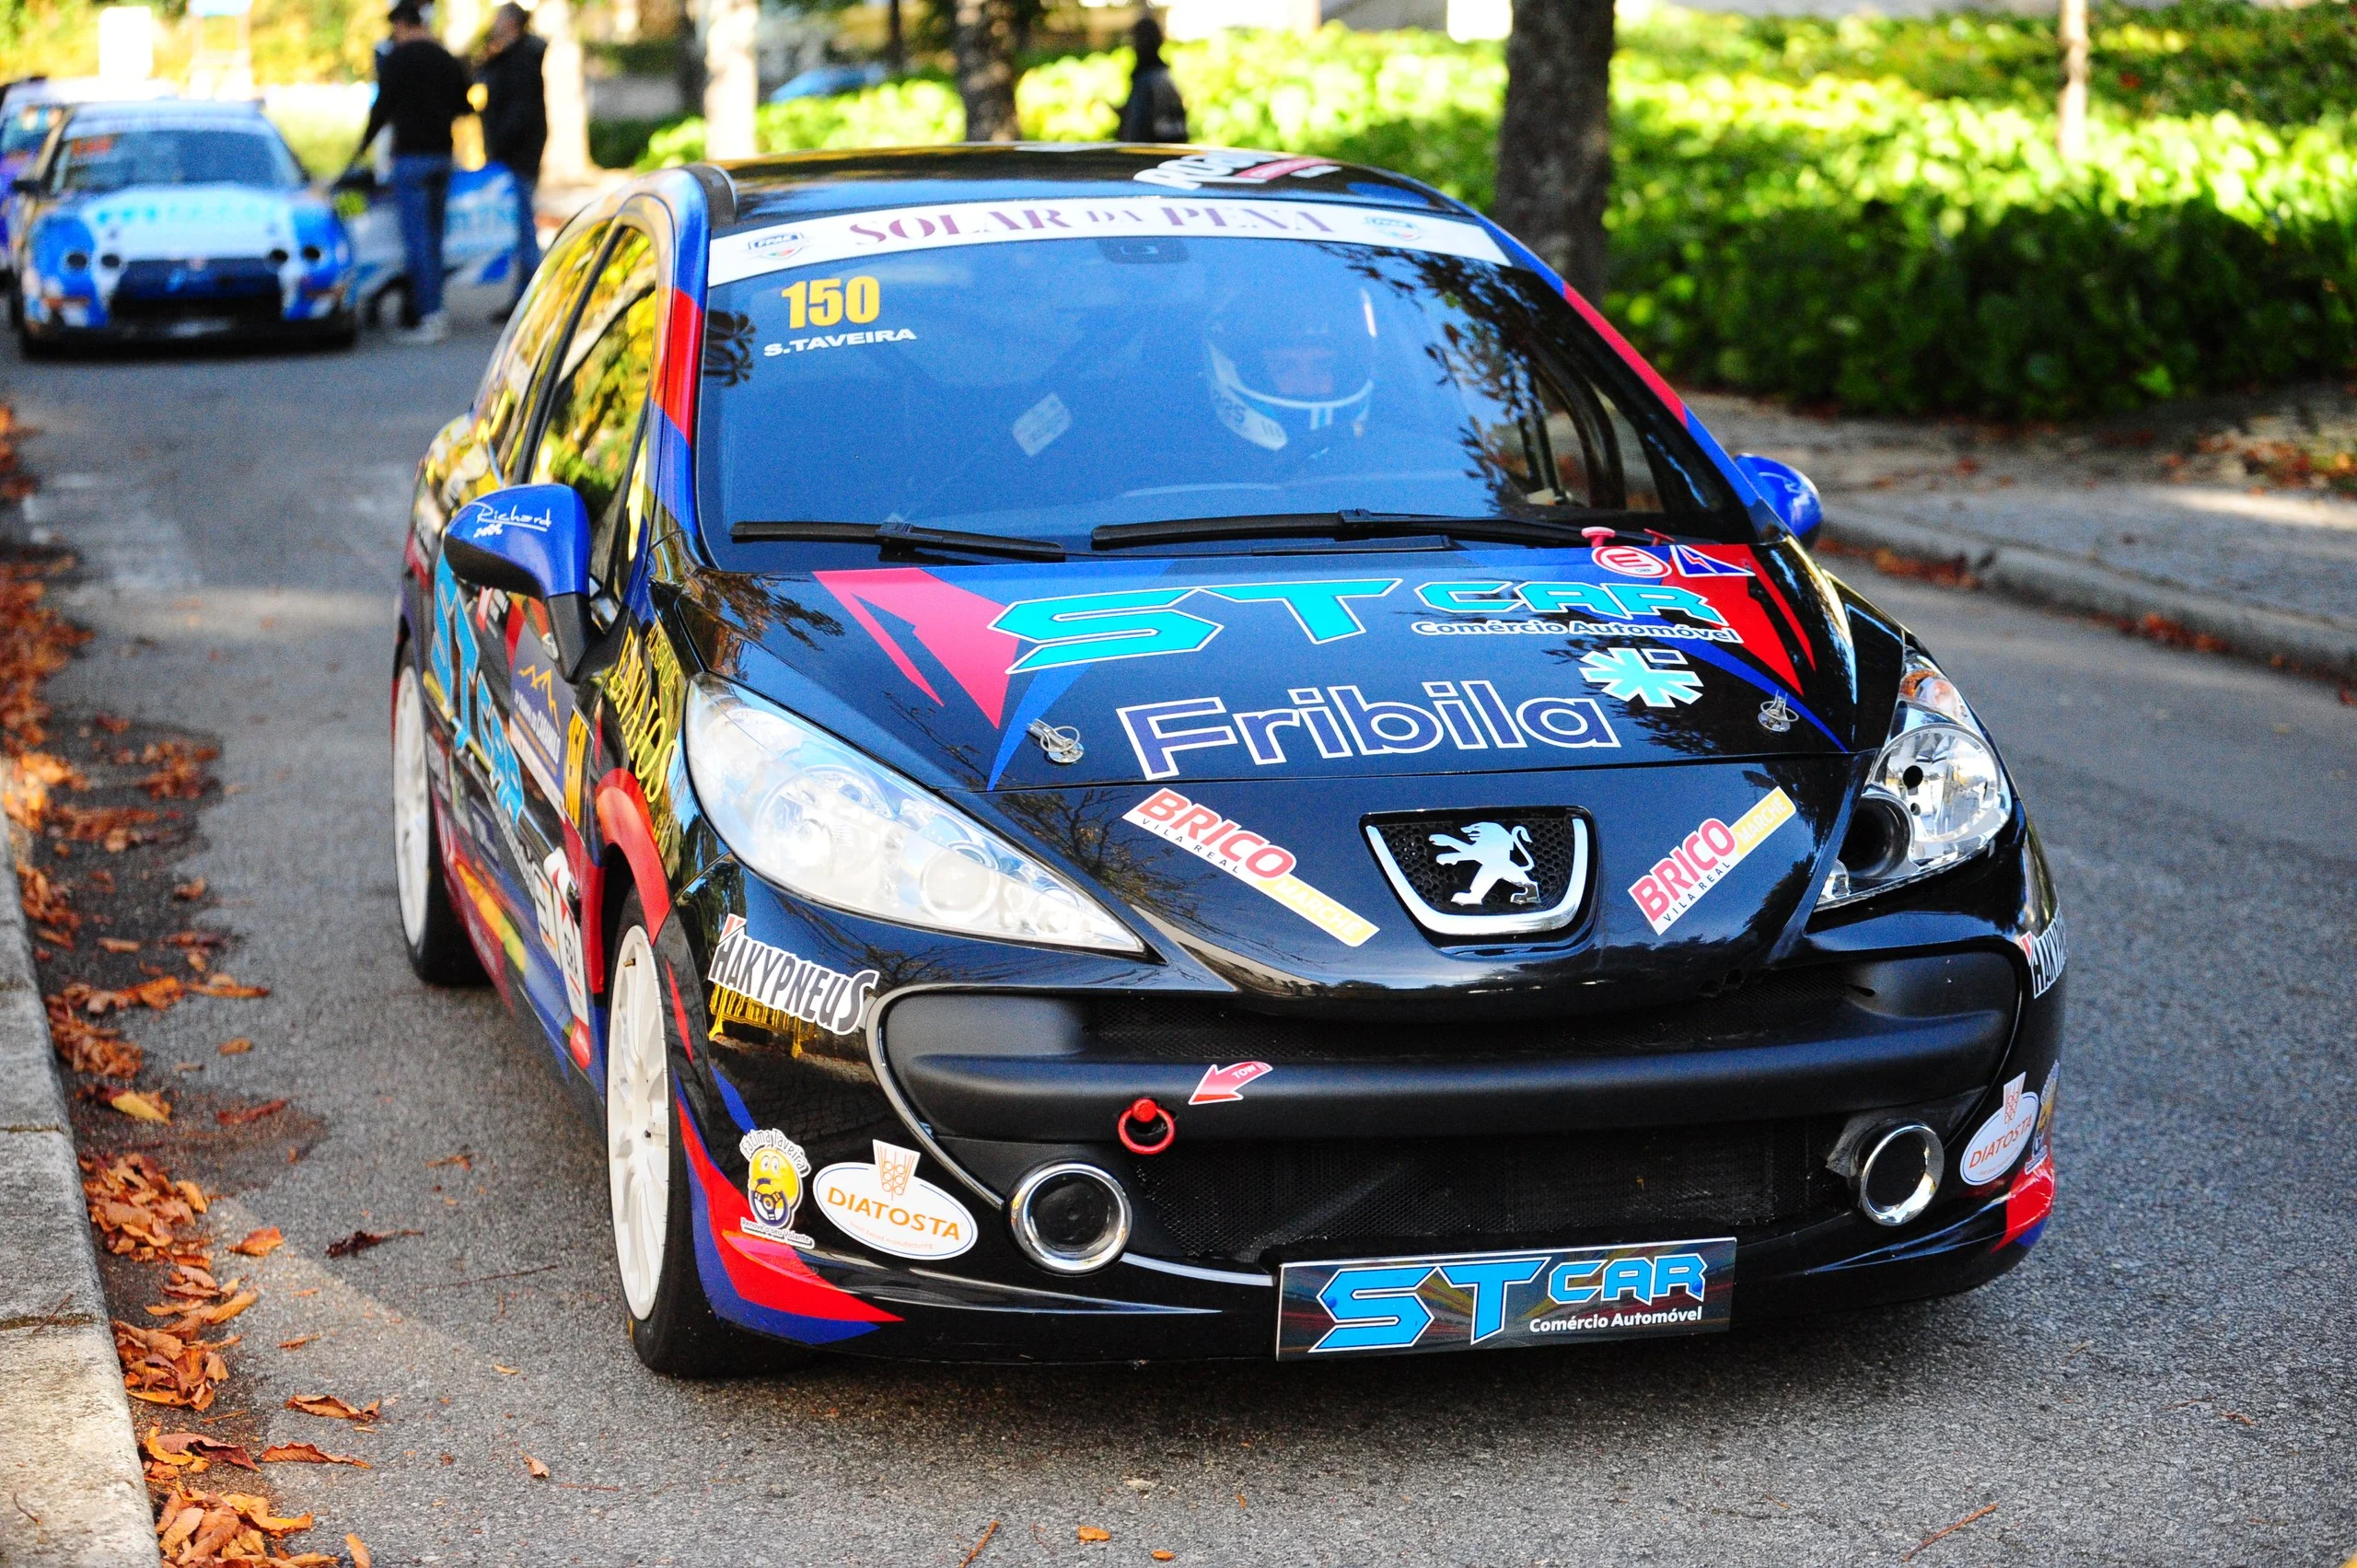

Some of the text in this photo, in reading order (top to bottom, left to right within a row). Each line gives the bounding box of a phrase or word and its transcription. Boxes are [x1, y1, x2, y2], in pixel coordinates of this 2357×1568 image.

[849, 208, 1071, 247] SOLAR
[1161, 206, 1334, 232] PENA
[782, 275, 881, 329] 150
[763, 328, 917, 357] S.TAVEIRA
[471, 502, 552, 528] Richard
[987, 578, 1730, 674] ST CAR
[1413, 621, 1742, 643] Comércio Automóvel
[1116, 679, 1622, 782] Fribila
[1137, 791, 1294, 878] BRICO
[1142, 818, 1239, 874] VILA REAL
[1631, 819, 1736, 922] BRICO
[1664, 862, 1731, 923] VILA REAL
[709, 934, 877, 1032] HAKYPNEUS
[1231, 1064, 1258, 1079] TOW
[1968, 1113, 2033, 1169] DIATOSTA
[827, 1186, 960, 1241] DIATOSTA
[1307, 1252, 1708, 1353] ST CAR
[1529, 1306, 1703, 1333] Comércio Automóvel
